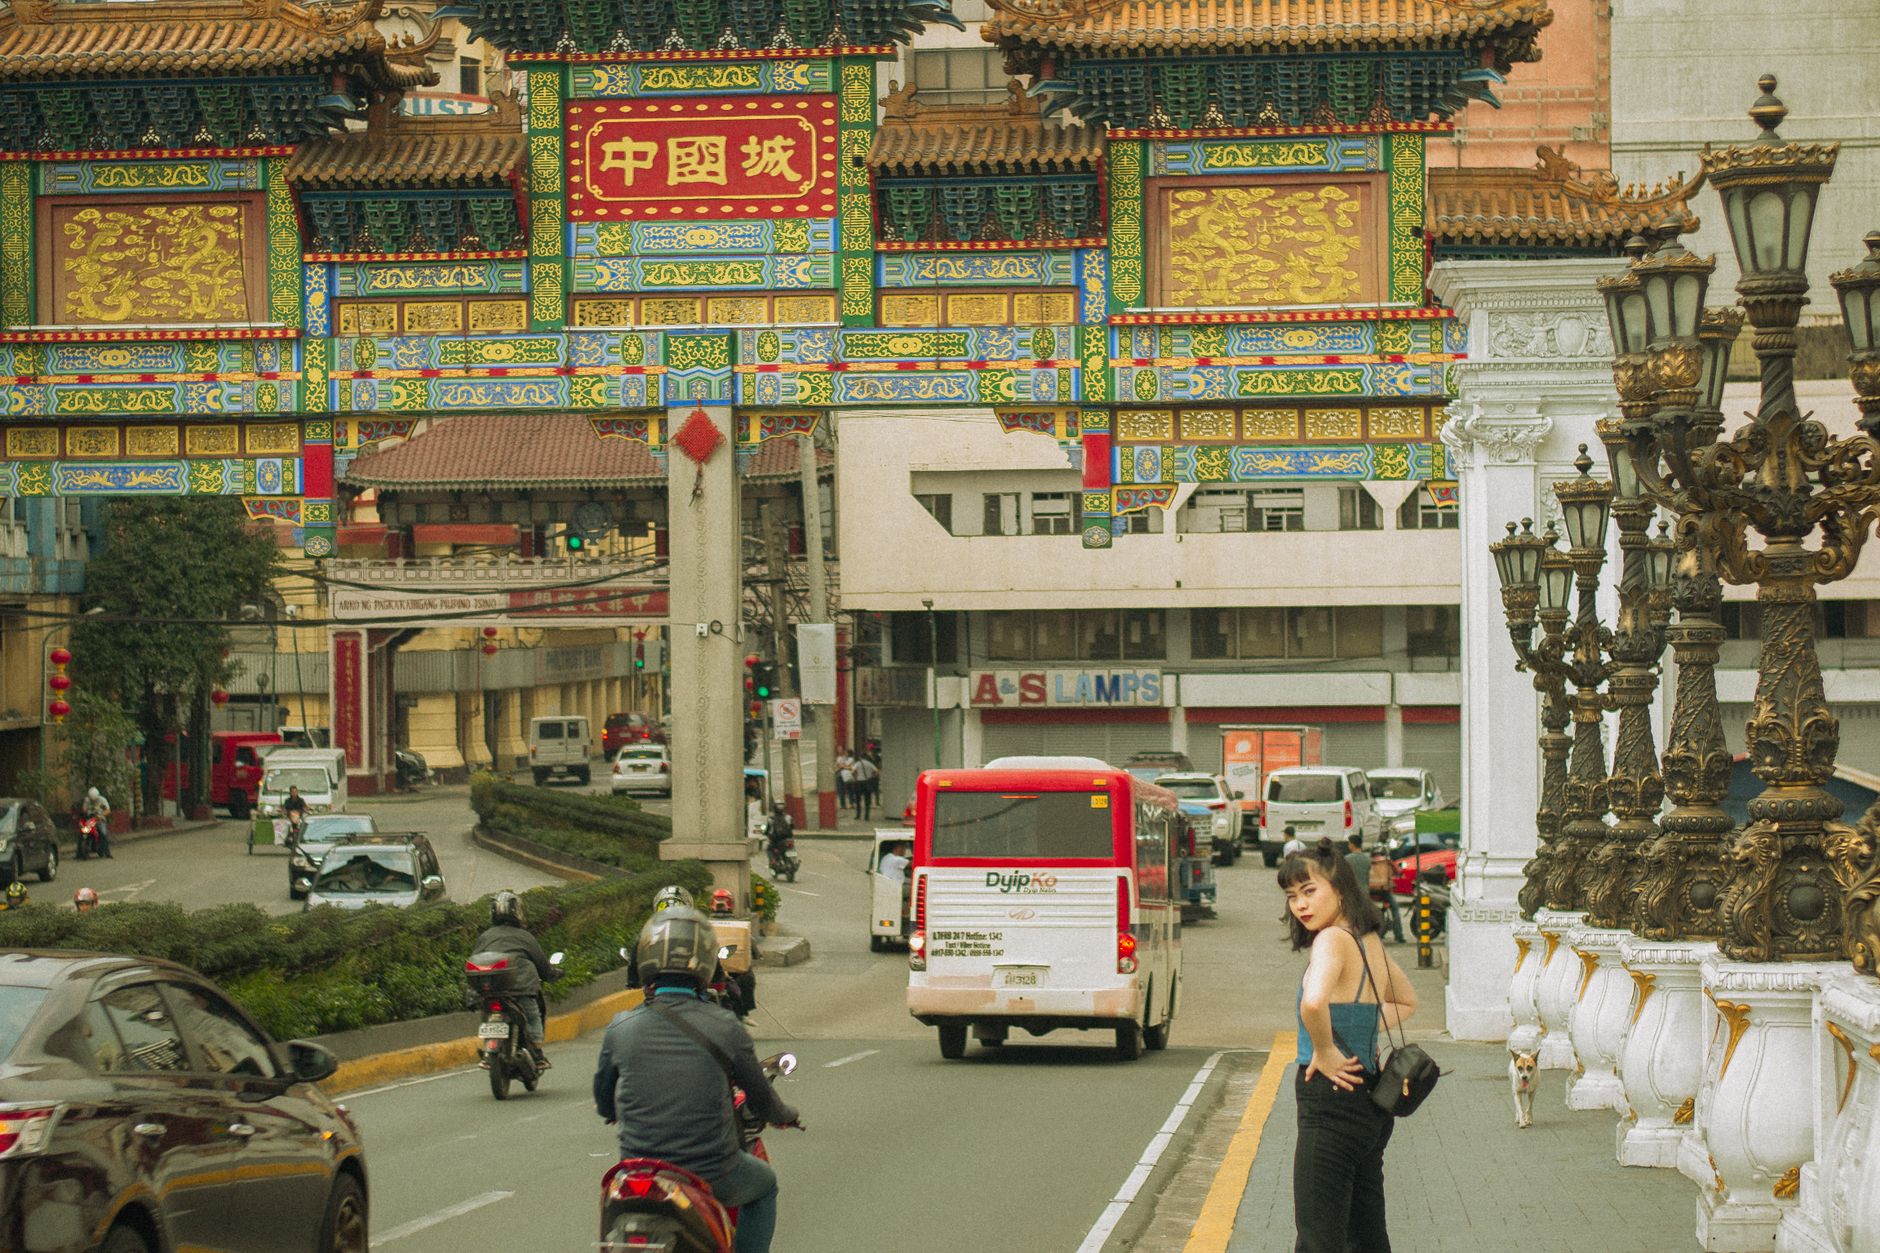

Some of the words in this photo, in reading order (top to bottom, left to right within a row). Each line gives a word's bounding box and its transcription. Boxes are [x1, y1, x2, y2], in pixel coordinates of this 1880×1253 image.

[601, 135, 802, 187] 中國城
[362, 599, 372, 610] NG
[1055, 673, 1160, 704] LAMPS
[986, 870, 1057, 893] DyipKo
